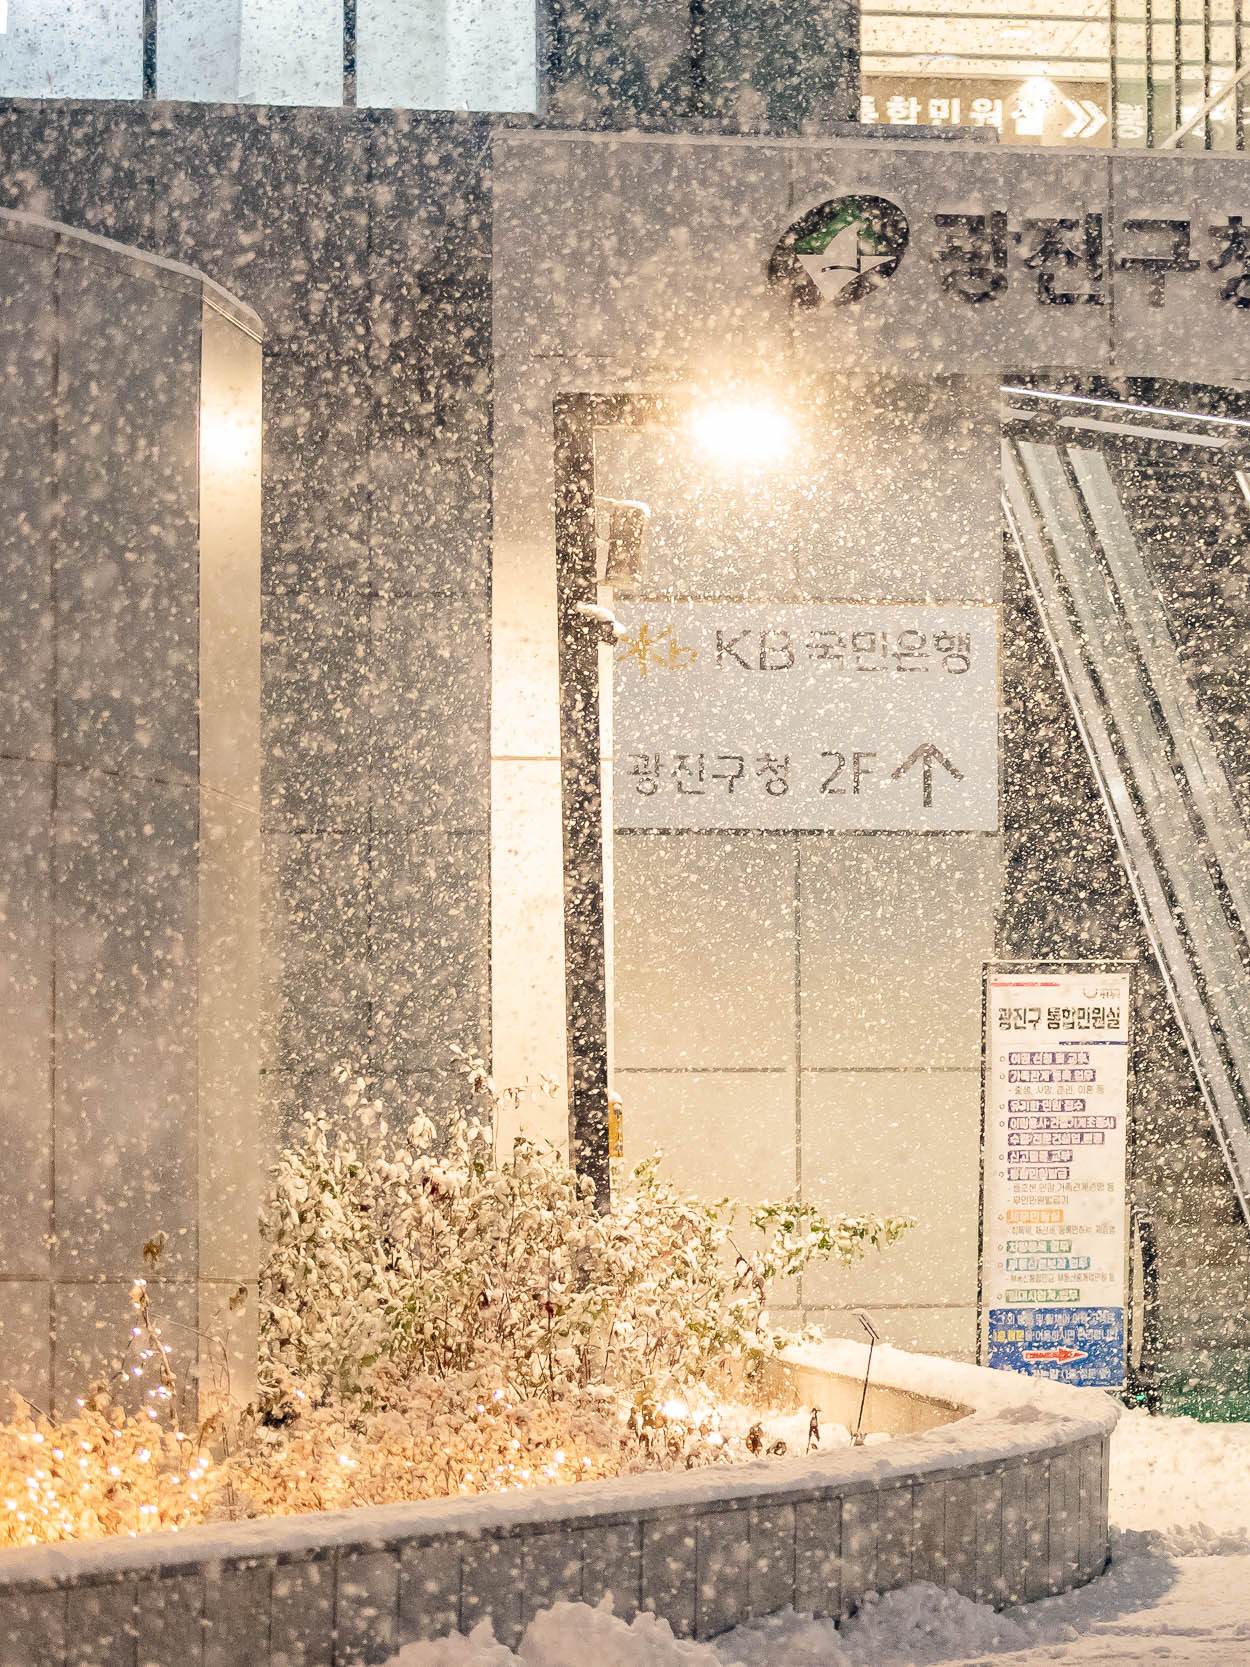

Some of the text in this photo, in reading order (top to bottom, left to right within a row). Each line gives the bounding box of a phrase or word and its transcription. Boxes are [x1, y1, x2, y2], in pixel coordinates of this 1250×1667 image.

[627, 751, 877, 797] 광진구청 2F
[998, 1007, 1120, 1030] 광진구 통합민원실
